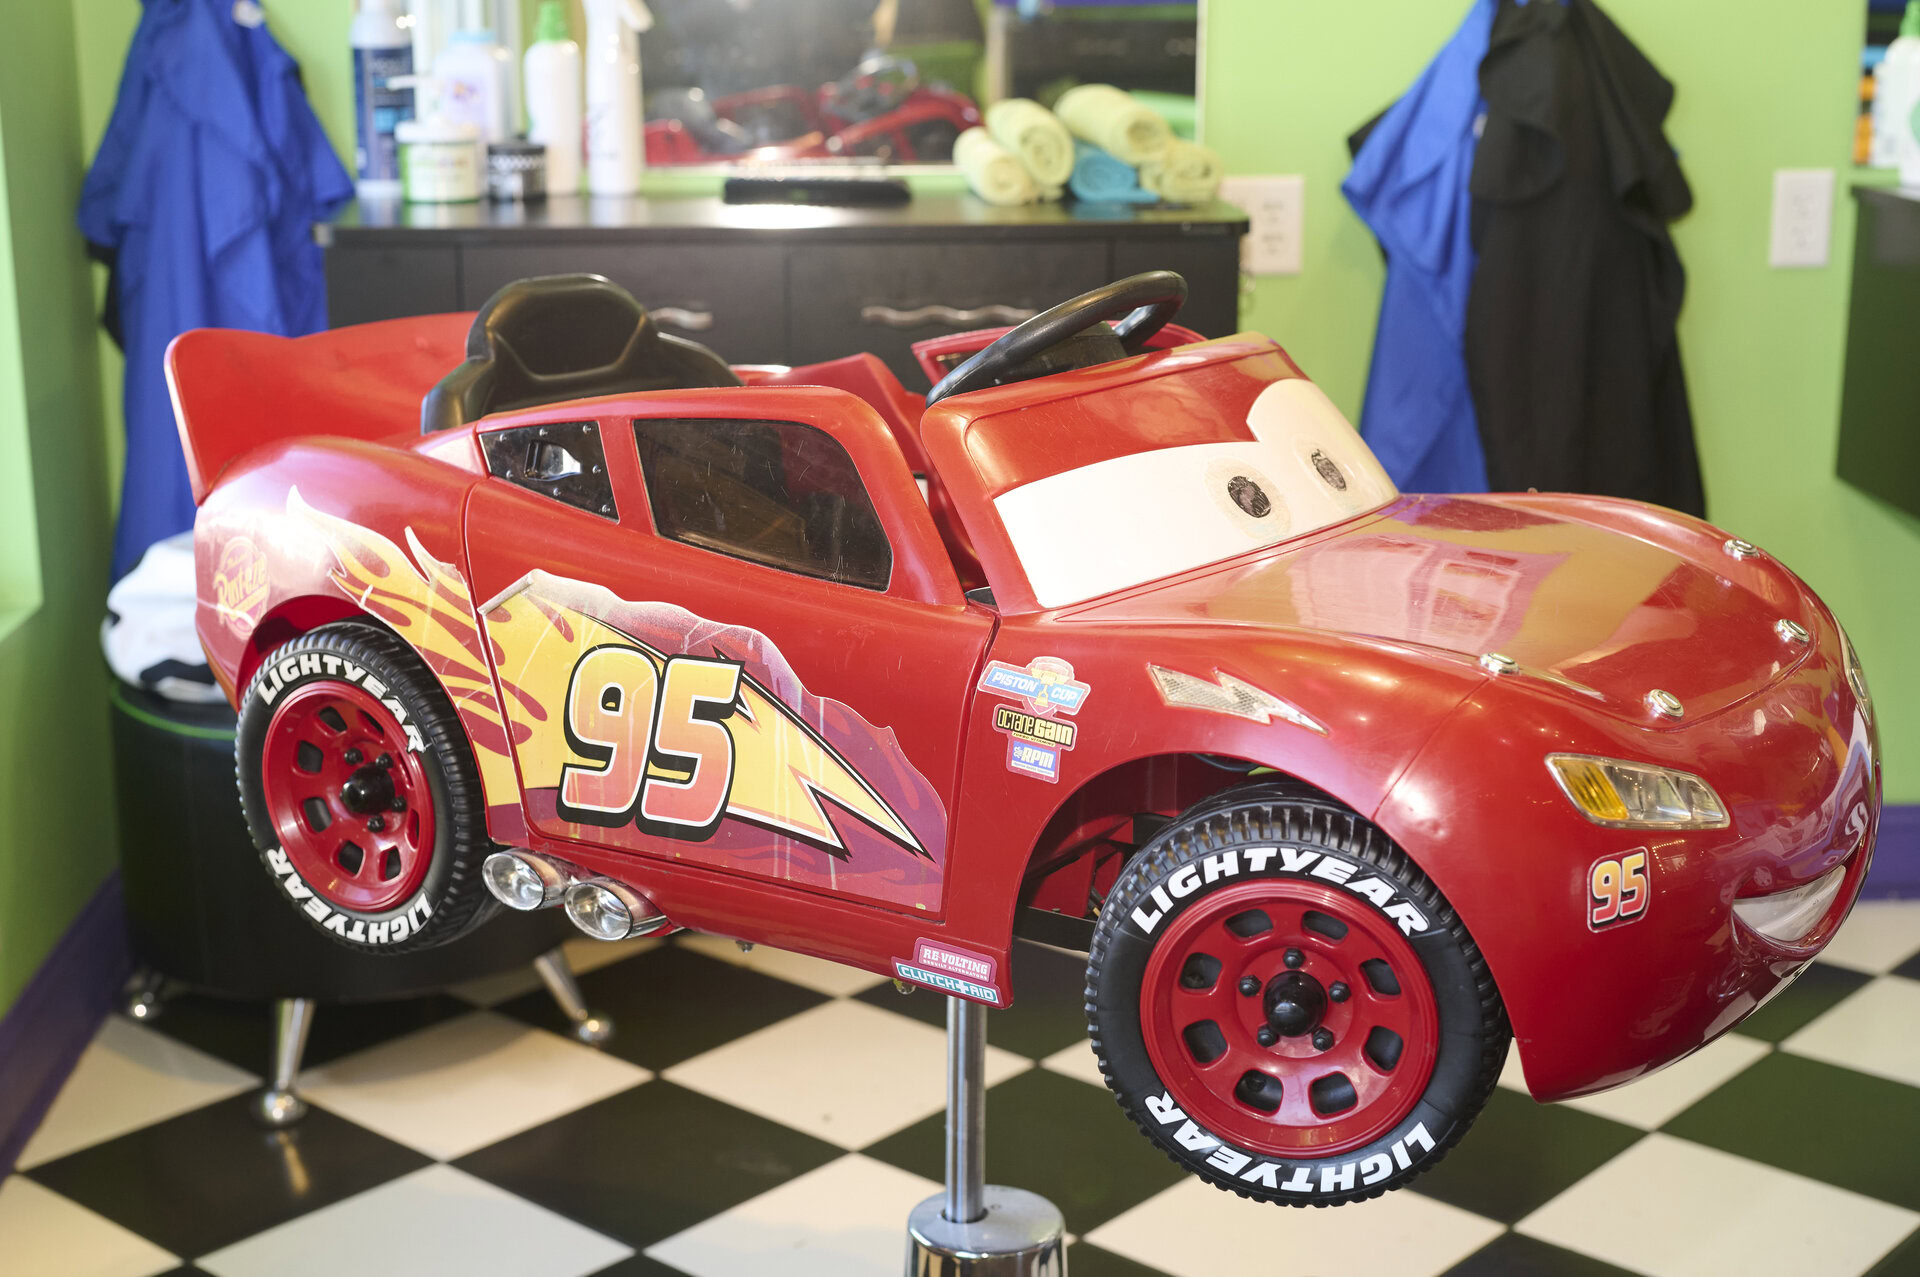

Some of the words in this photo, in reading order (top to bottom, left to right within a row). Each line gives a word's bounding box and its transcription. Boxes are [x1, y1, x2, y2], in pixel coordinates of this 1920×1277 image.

[256, 652, 425, 754] LIGHTYEAR
[991, 671, 1039, 693] PISTON
[1050, 686, 1079, 702] CUP
[557, 644, 741, 840] 95
[266, 845, 434, 944] LIGHTYEAR
[1130, 847, 1430, 937] LIGHTYEAR
[1591, 851, 1648, 926] 95
[1144, 1090, 1437, 1193] LIGHTYEAR
